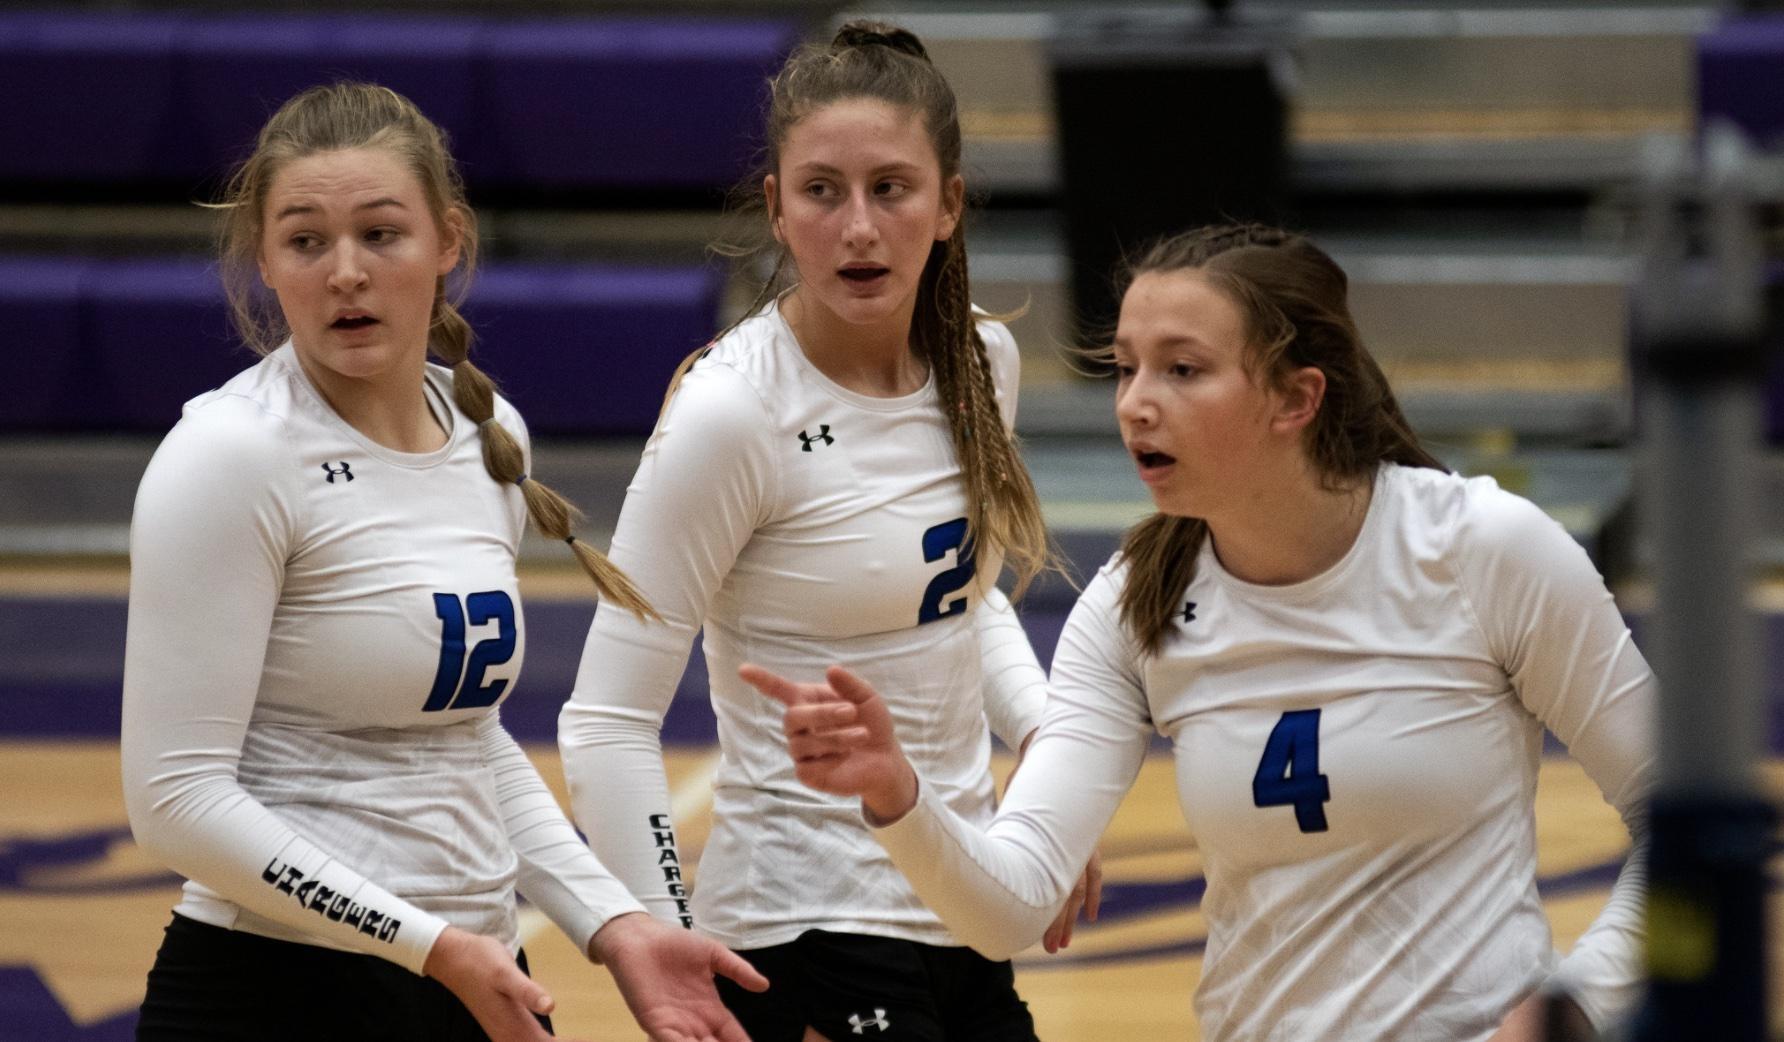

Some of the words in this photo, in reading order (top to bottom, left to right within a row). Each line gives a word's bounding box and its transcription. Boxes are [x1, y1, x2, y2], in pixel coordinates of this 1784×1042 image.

[918, 517, 977, 625] 2
[421, 590, 517, 712] 12
[1252, 708, 1331, 834] 4
[262, 857, 402, 944] CHARGERS
[649, 814, 695, 930] CHARGER
